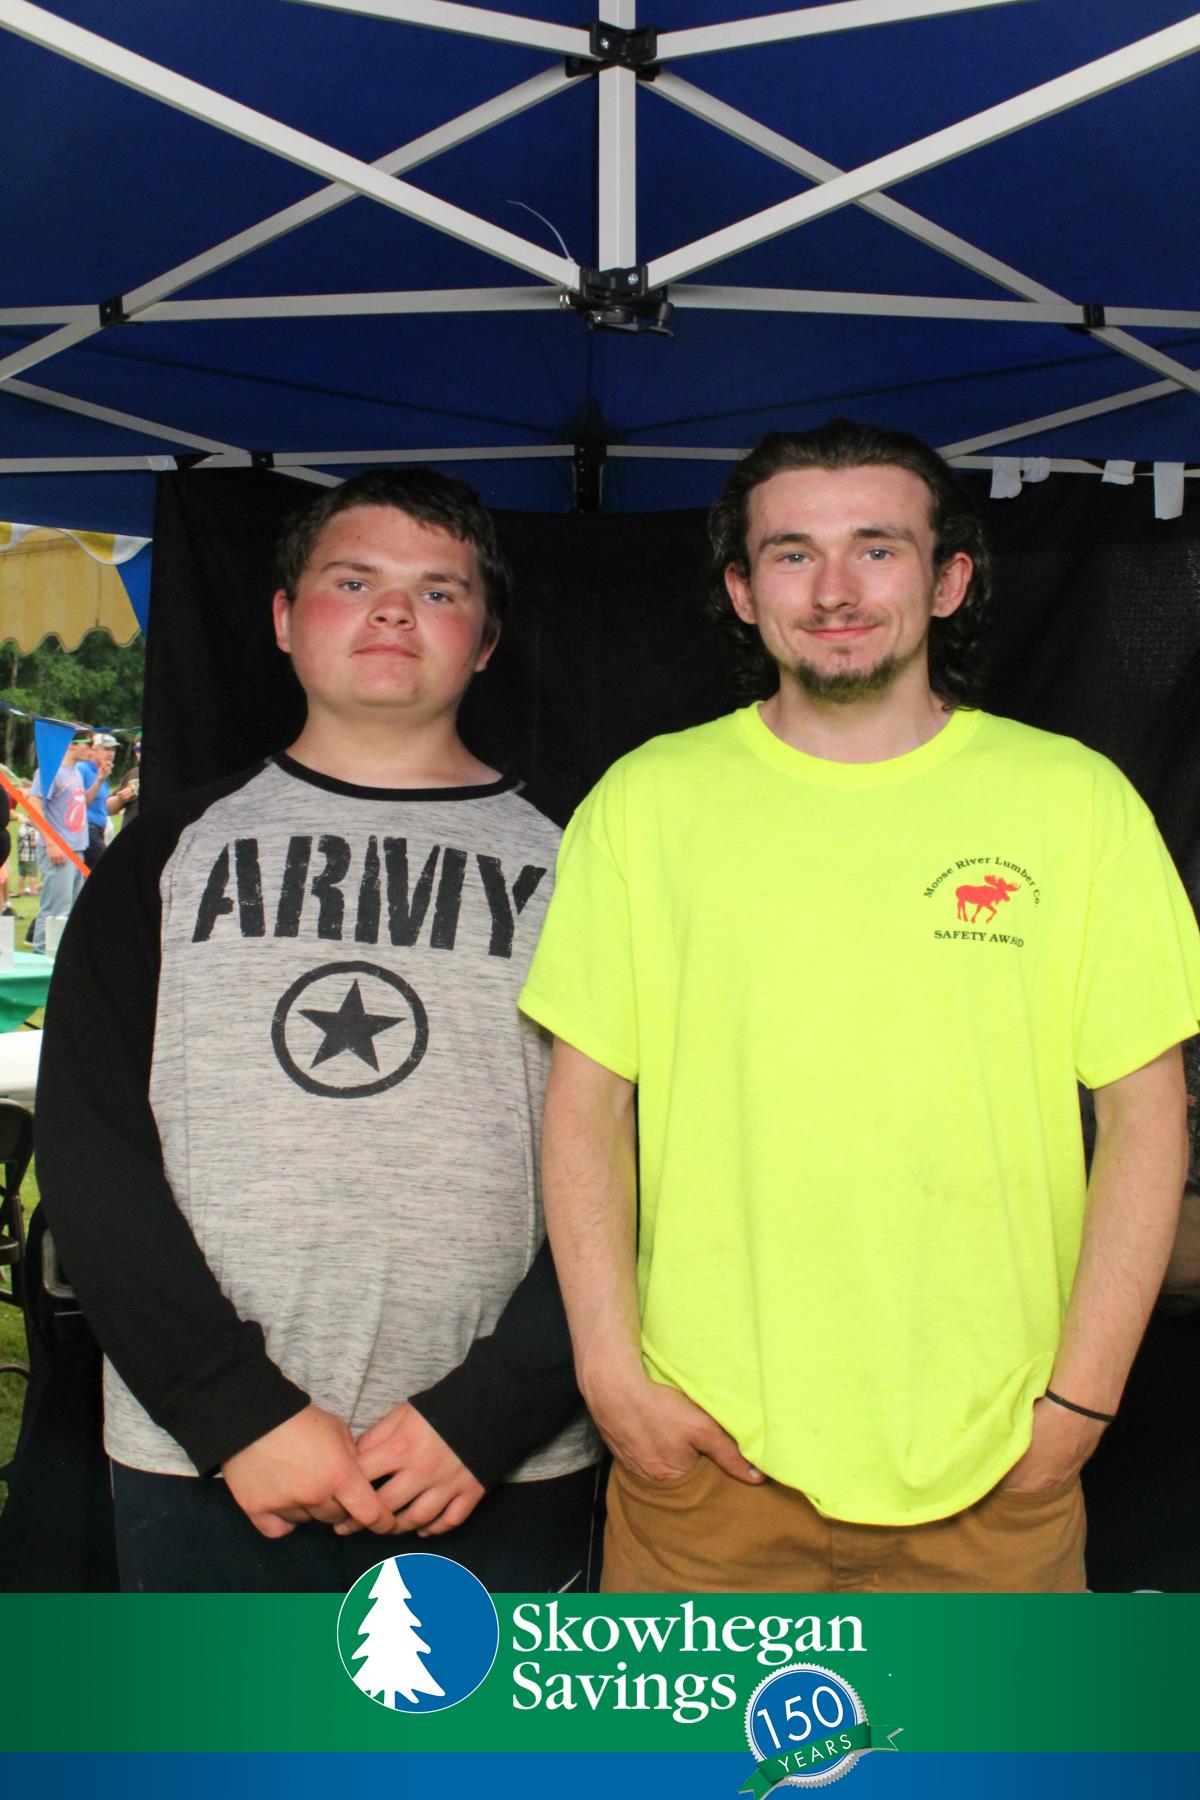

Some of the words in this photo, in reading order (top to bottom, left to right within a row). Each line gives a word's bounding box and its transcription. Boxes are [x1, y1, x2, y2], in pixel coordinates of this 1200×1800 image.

[191, 834, 548, 958] ARMY
[923, 867, 954, 898] Moose
[955, 857, 991, 870] River
[995, 857, 1036, 887] Lumber
[934, 930, 987, 942] SAFETY
